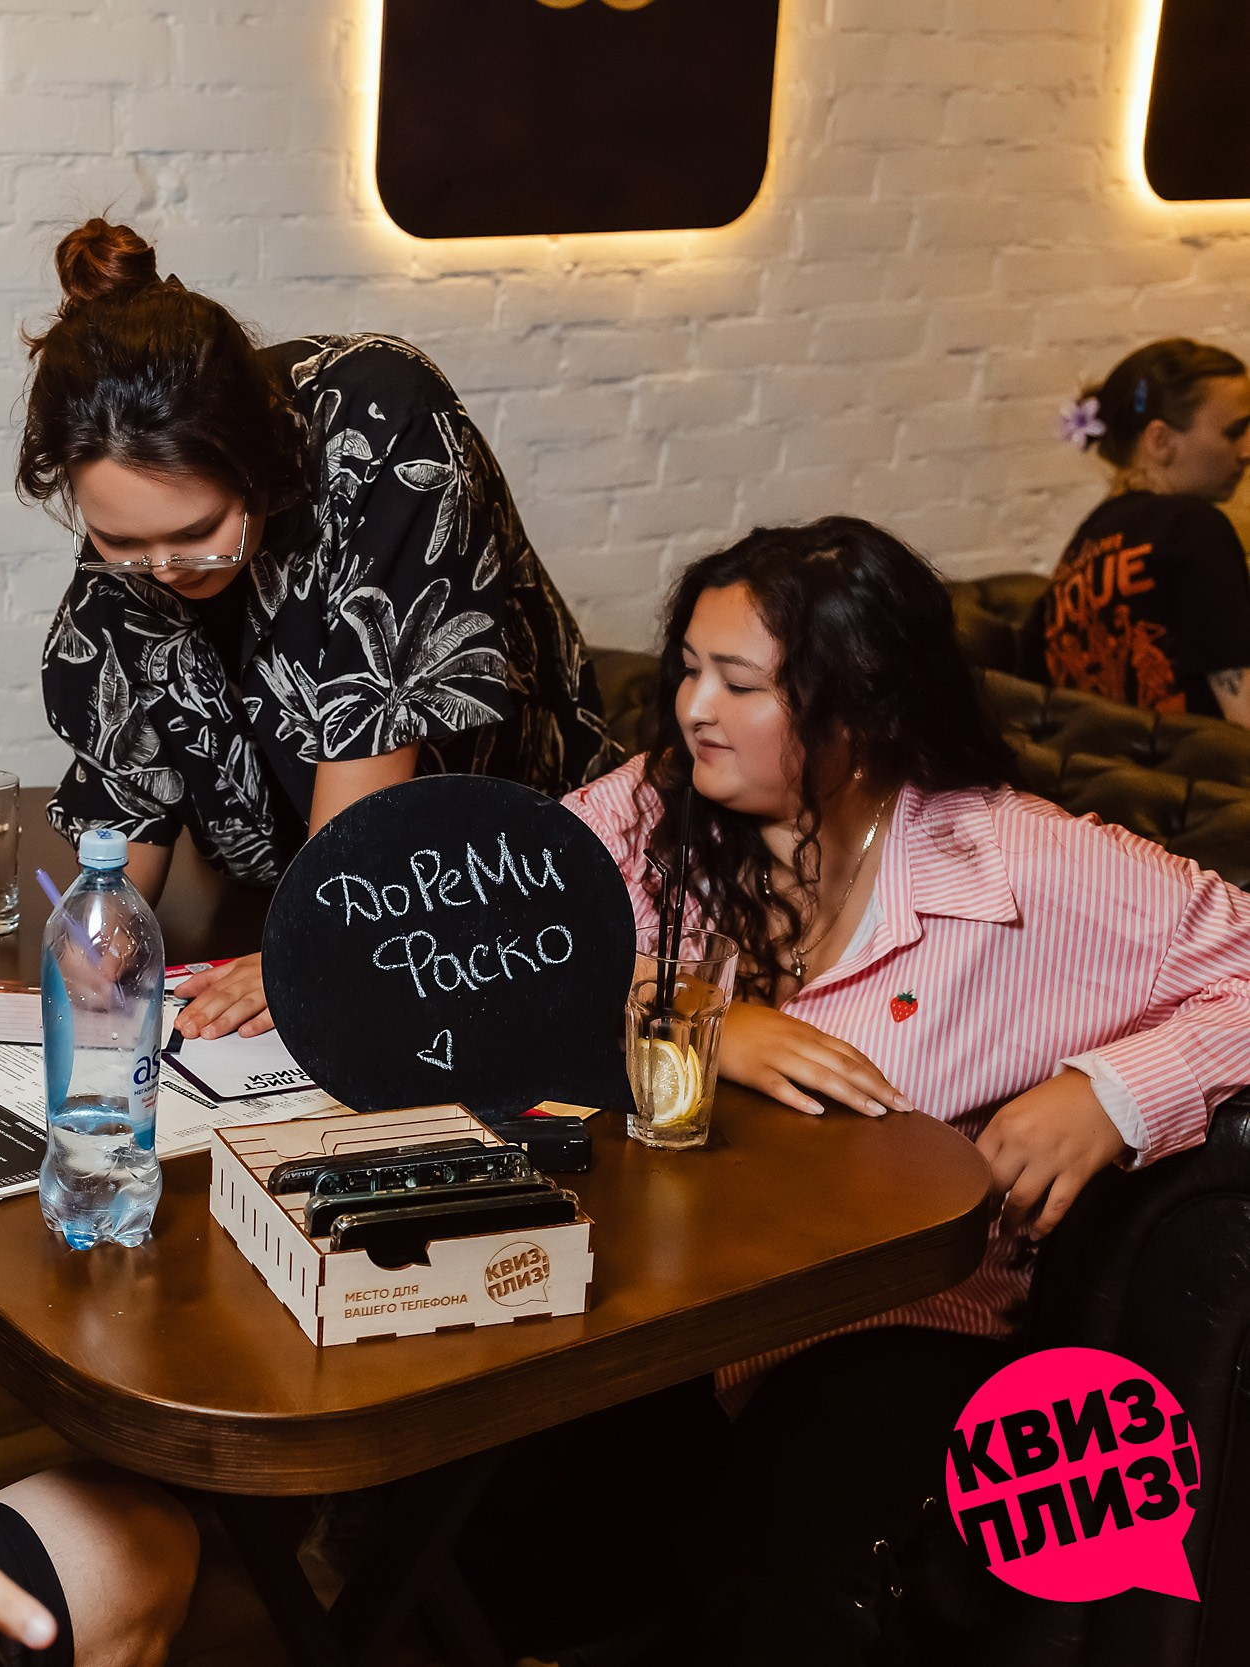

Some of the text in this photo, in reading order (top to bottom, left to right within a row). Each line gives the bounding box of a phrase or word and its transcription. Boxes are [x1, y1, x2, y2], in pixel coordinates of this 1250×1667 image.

[345, 1284, 419, 1303] МЕСТО ДЛЯ
[344, 1294, 468, 1319] ВАШЕГО ТЕЛЕФОНА
